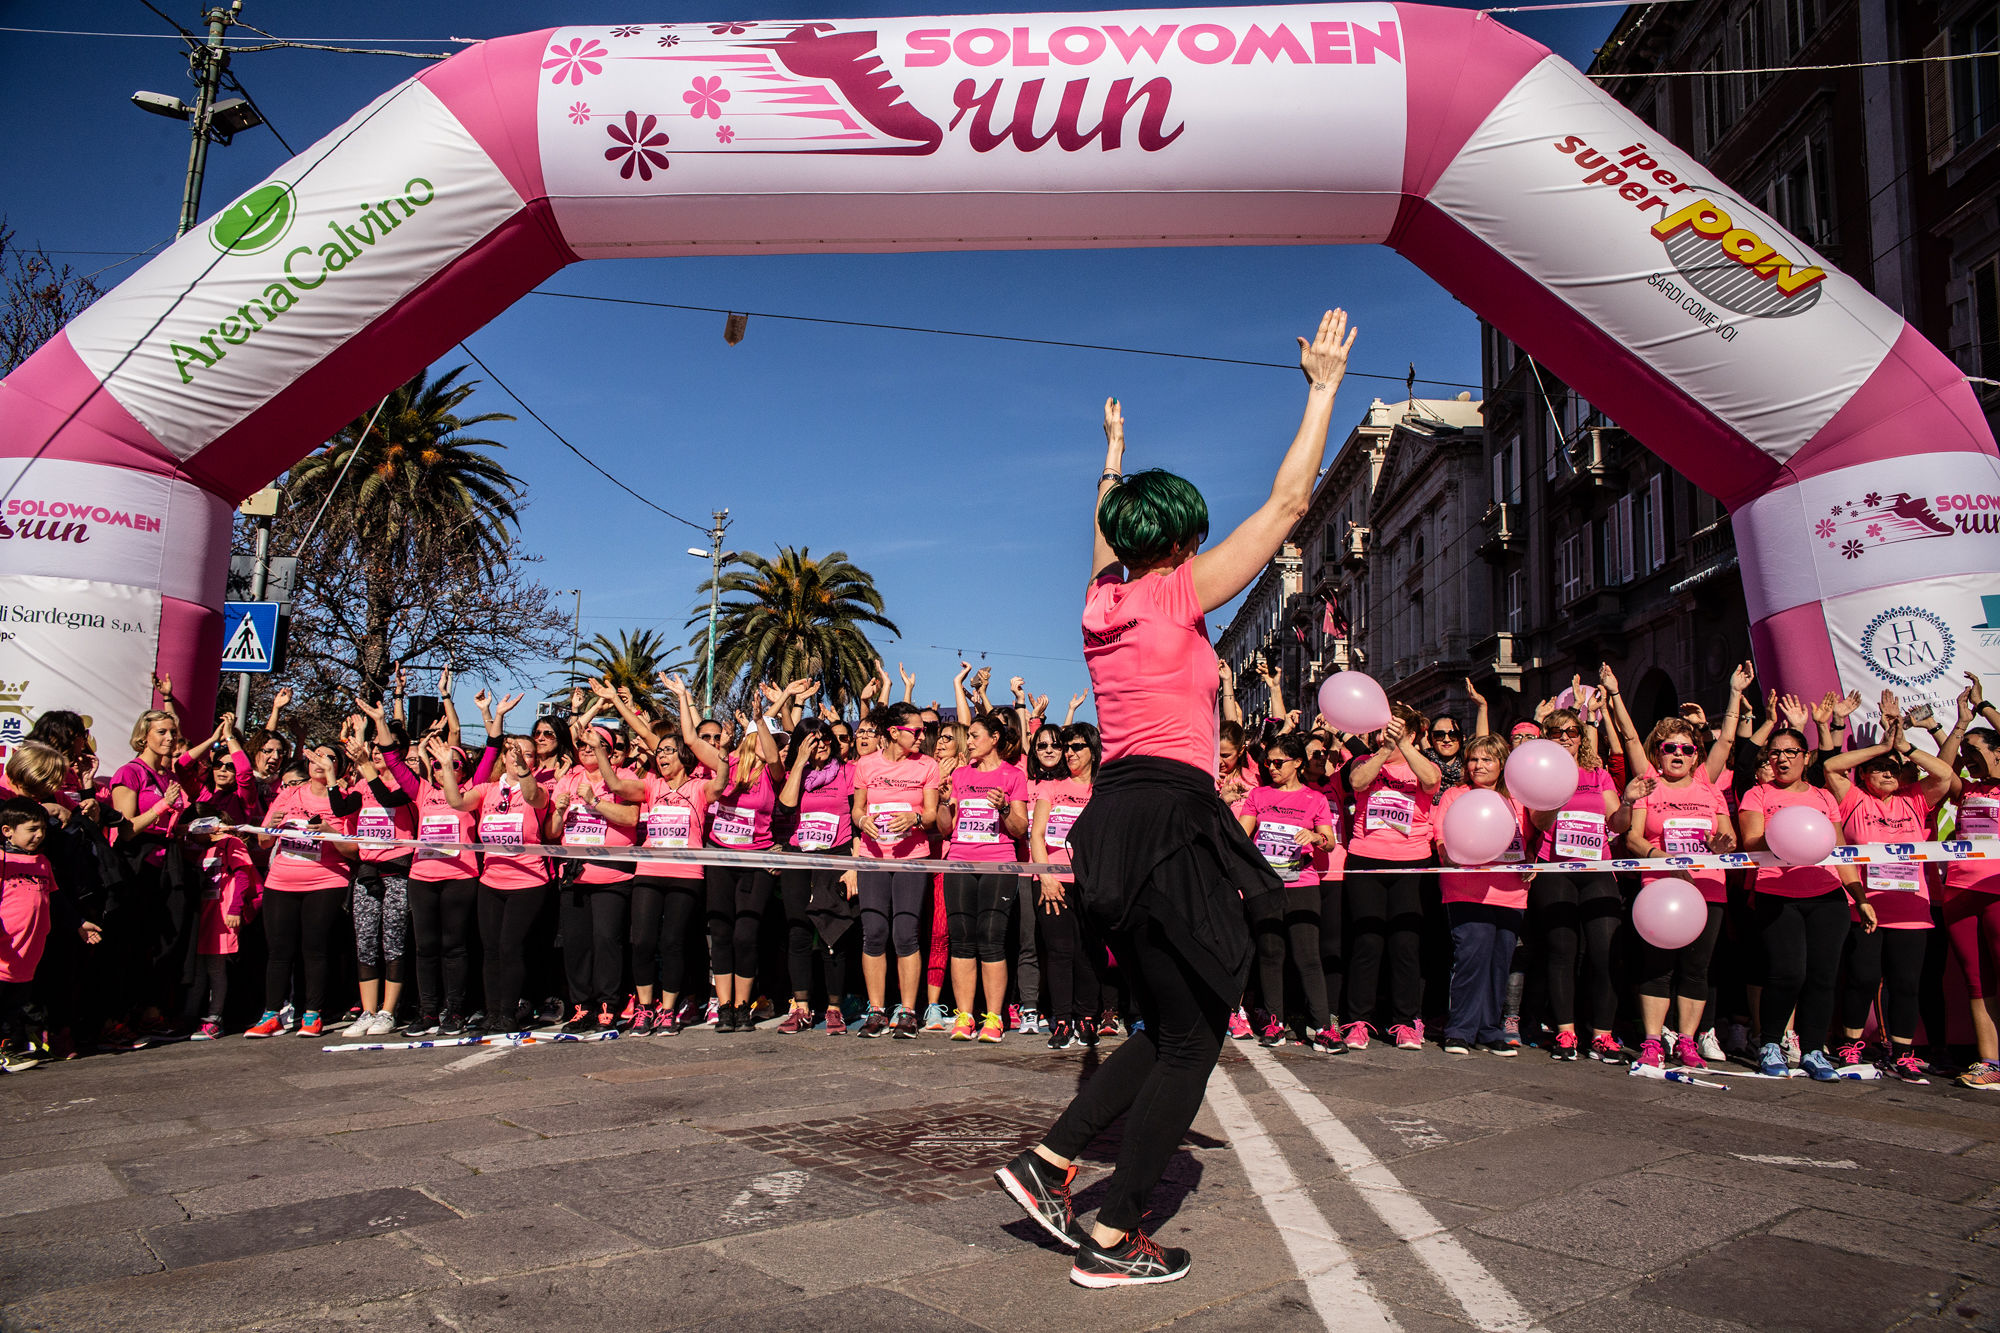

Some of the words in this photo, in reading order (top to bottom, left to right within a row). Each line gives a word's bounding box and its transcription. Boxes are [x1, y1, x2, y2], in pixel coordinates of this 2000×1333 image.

[904, 21, 1401, 67] SOLOWOMEN
[949, 76, 1184, 153] run
[1554, 135, 1669, 212] super
[1618, 142, 1696, 195] iper
[169, 177, 435, 384] ArenaCalvino
[1647, 272, 1682, 303] SARDI
[1681, 297, 1718, 329] COME
[1715, 321, 1738, 343] VOI
[6, 500, 161, 533] SOLOWOMEN
[16, 519, 90, 544] run
[11, 605, 105, 629] Sardegna
[111, 618, 146, 633] S.p.A.
[1889, 620, 1919, 645] H
[1881, 641, 1940, 669] RM
[1380, 809, 1410, 823] 11001
[366, 828, 392, 838] 13793
[491, 835, 520, 845] 13504
[657, 827, 687, 837] 10502
[806, 830, 833, 843] 12319
[1570, 834, 1601, 848] 11060
